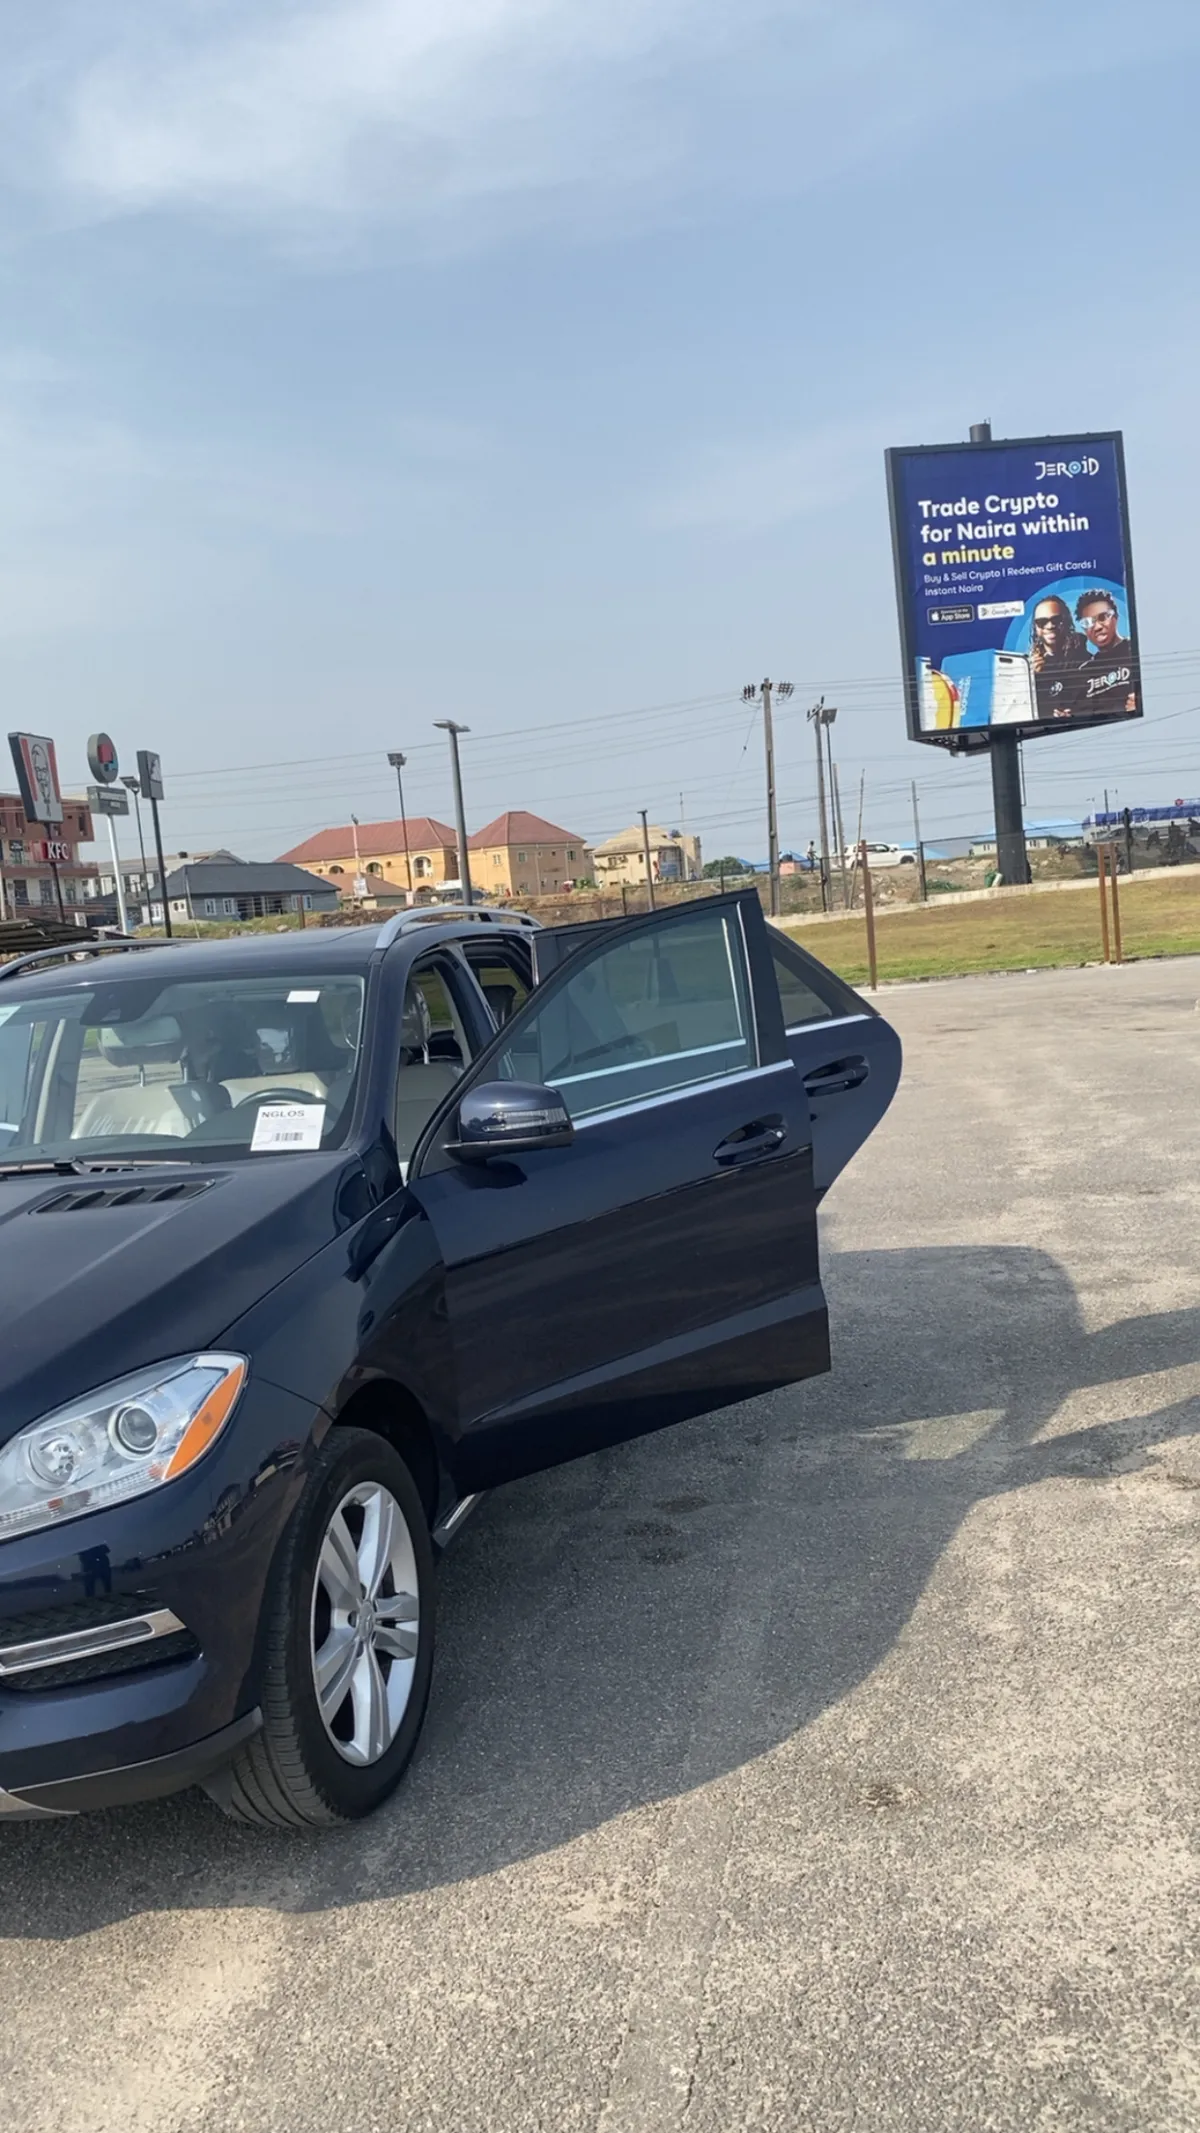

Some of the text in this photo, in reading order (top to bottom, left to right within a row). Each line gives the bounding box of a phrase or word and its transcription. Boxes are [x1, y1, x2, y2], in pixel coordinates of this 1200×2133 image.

[918, 491, 1059, 518] Trade Crypto
[921, 512, 1090, 543] for Naira within
[922, 544, 1015, 566] a minute
[924, 574, 942, 585] Buy
[943, 573, 950, 582] &
[951, 571, 968, 581] Sell
[969, 569, 1001, 581] Crypto
[1007, 565, 1045, 577] Redeem
[1046, 562, 1064, 573] Gift
[1065, 560, 1091, 571] Cards
[924, 583, 984, 597] Instant Naira
[941, 612, 970, 621] App Store
[47, 842, 69, 860] KFC
[261, 1109, 305, 1118] NGLOS
